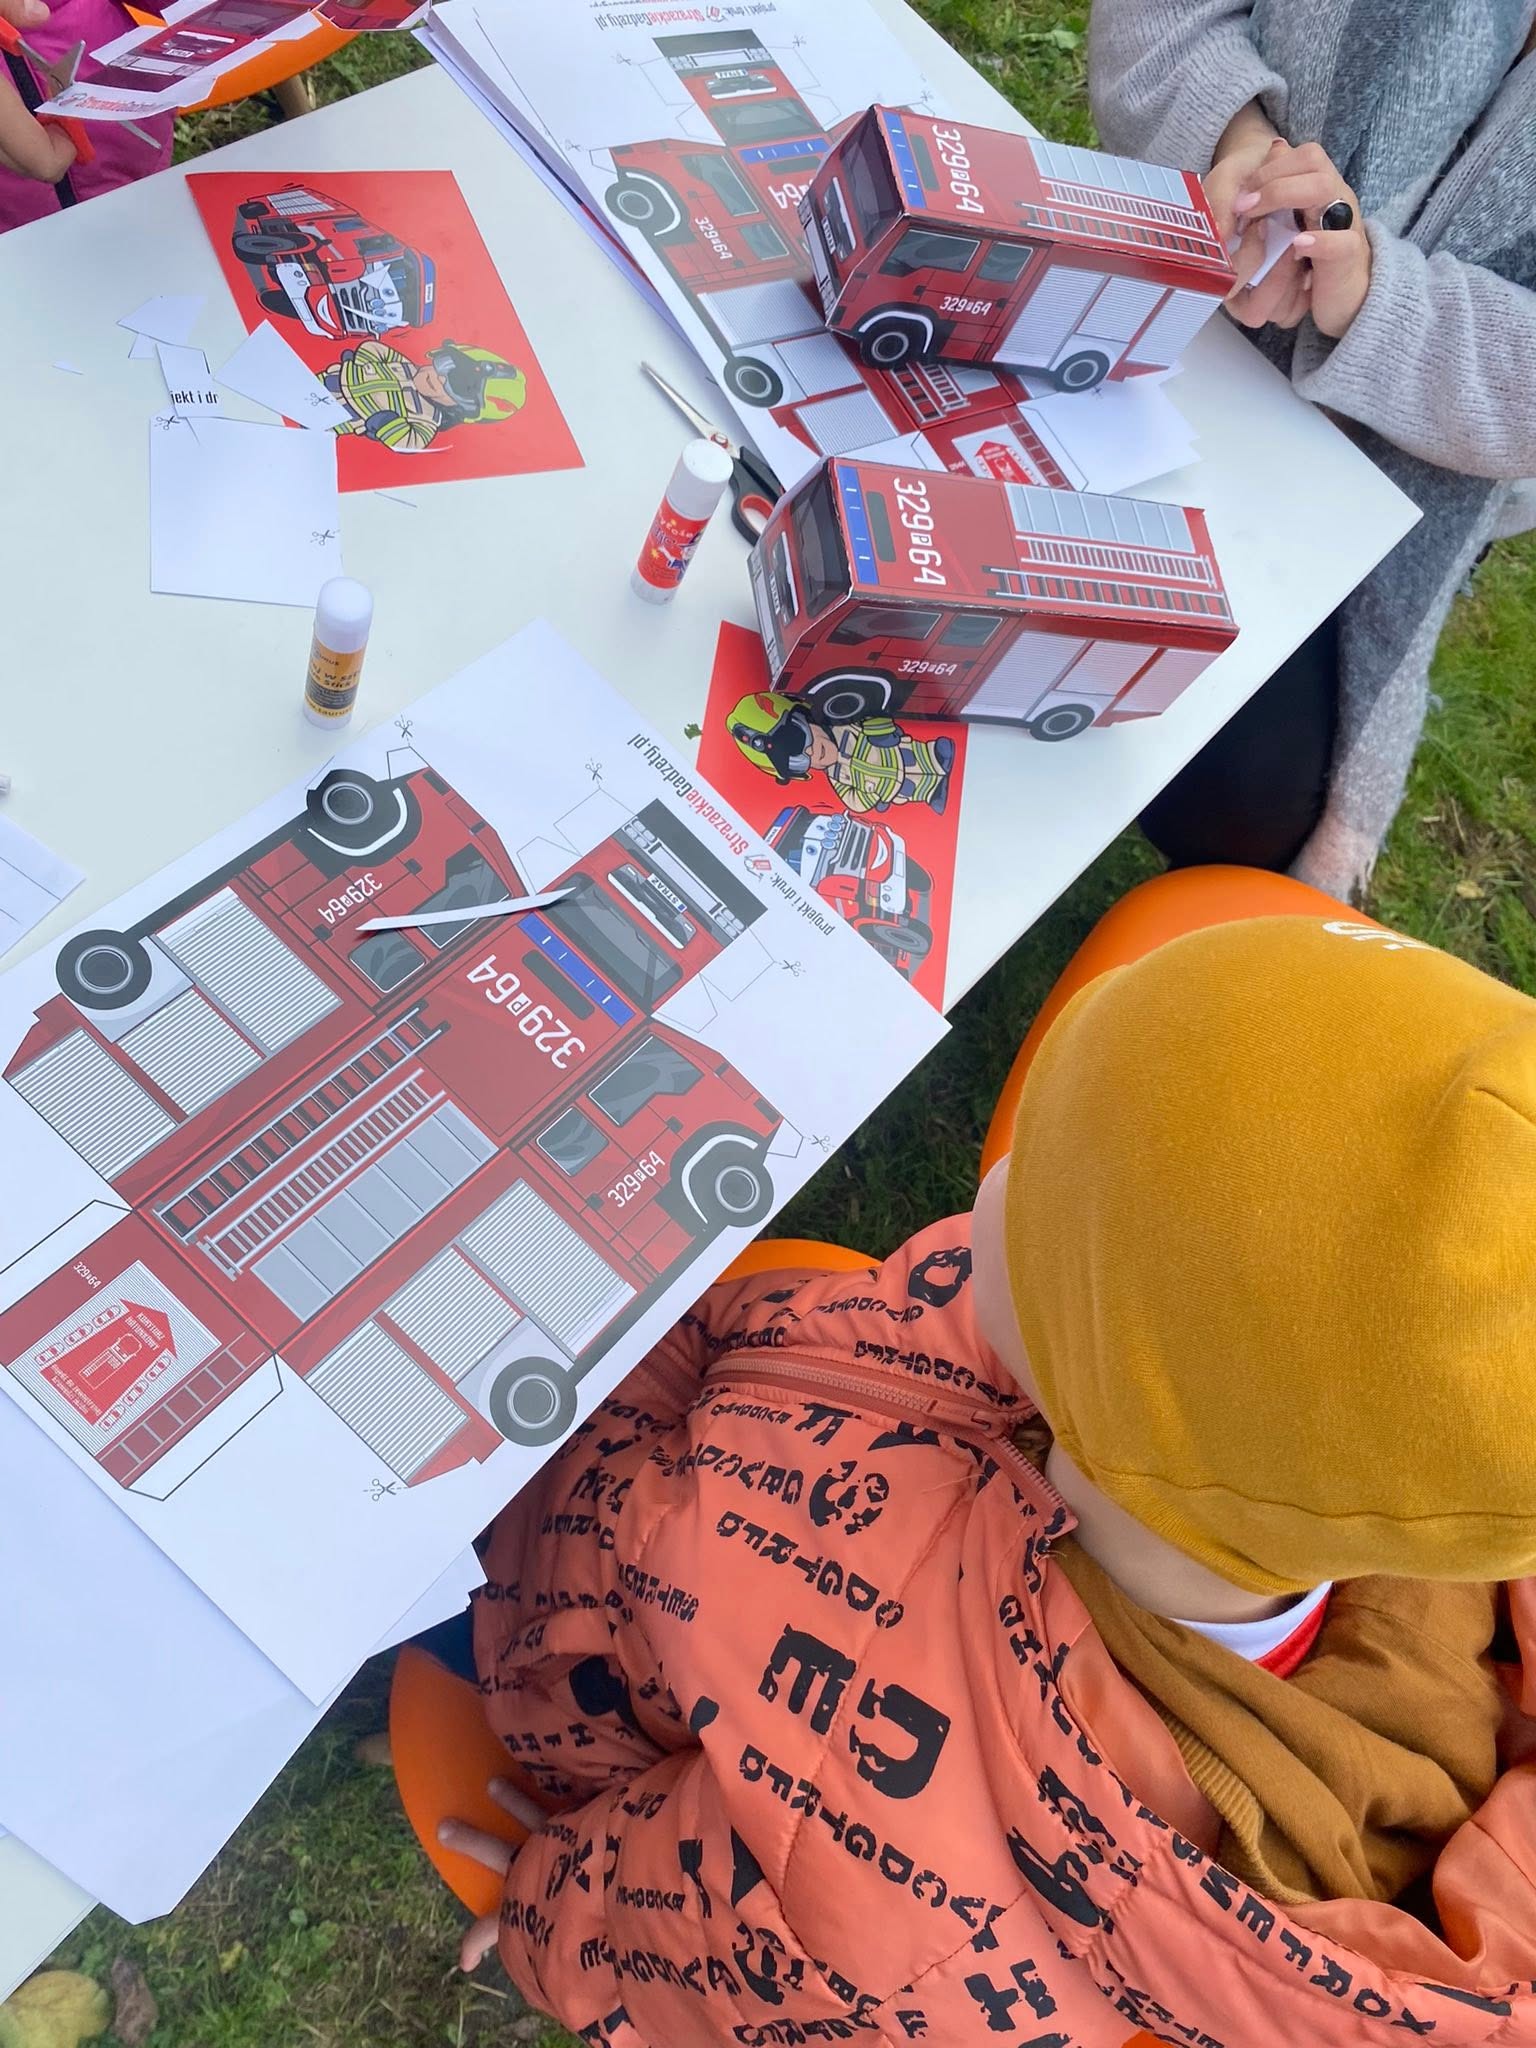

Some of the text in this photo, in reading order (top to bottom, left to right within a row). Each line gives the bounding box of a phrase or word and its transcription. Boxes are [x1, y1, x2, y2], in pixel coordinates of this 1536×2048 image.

[627, 733, 749, 856] StrazackieGadzety.pl
[769, 872, 797, 900] druk:
[797, 901, 836, 936] projekt
